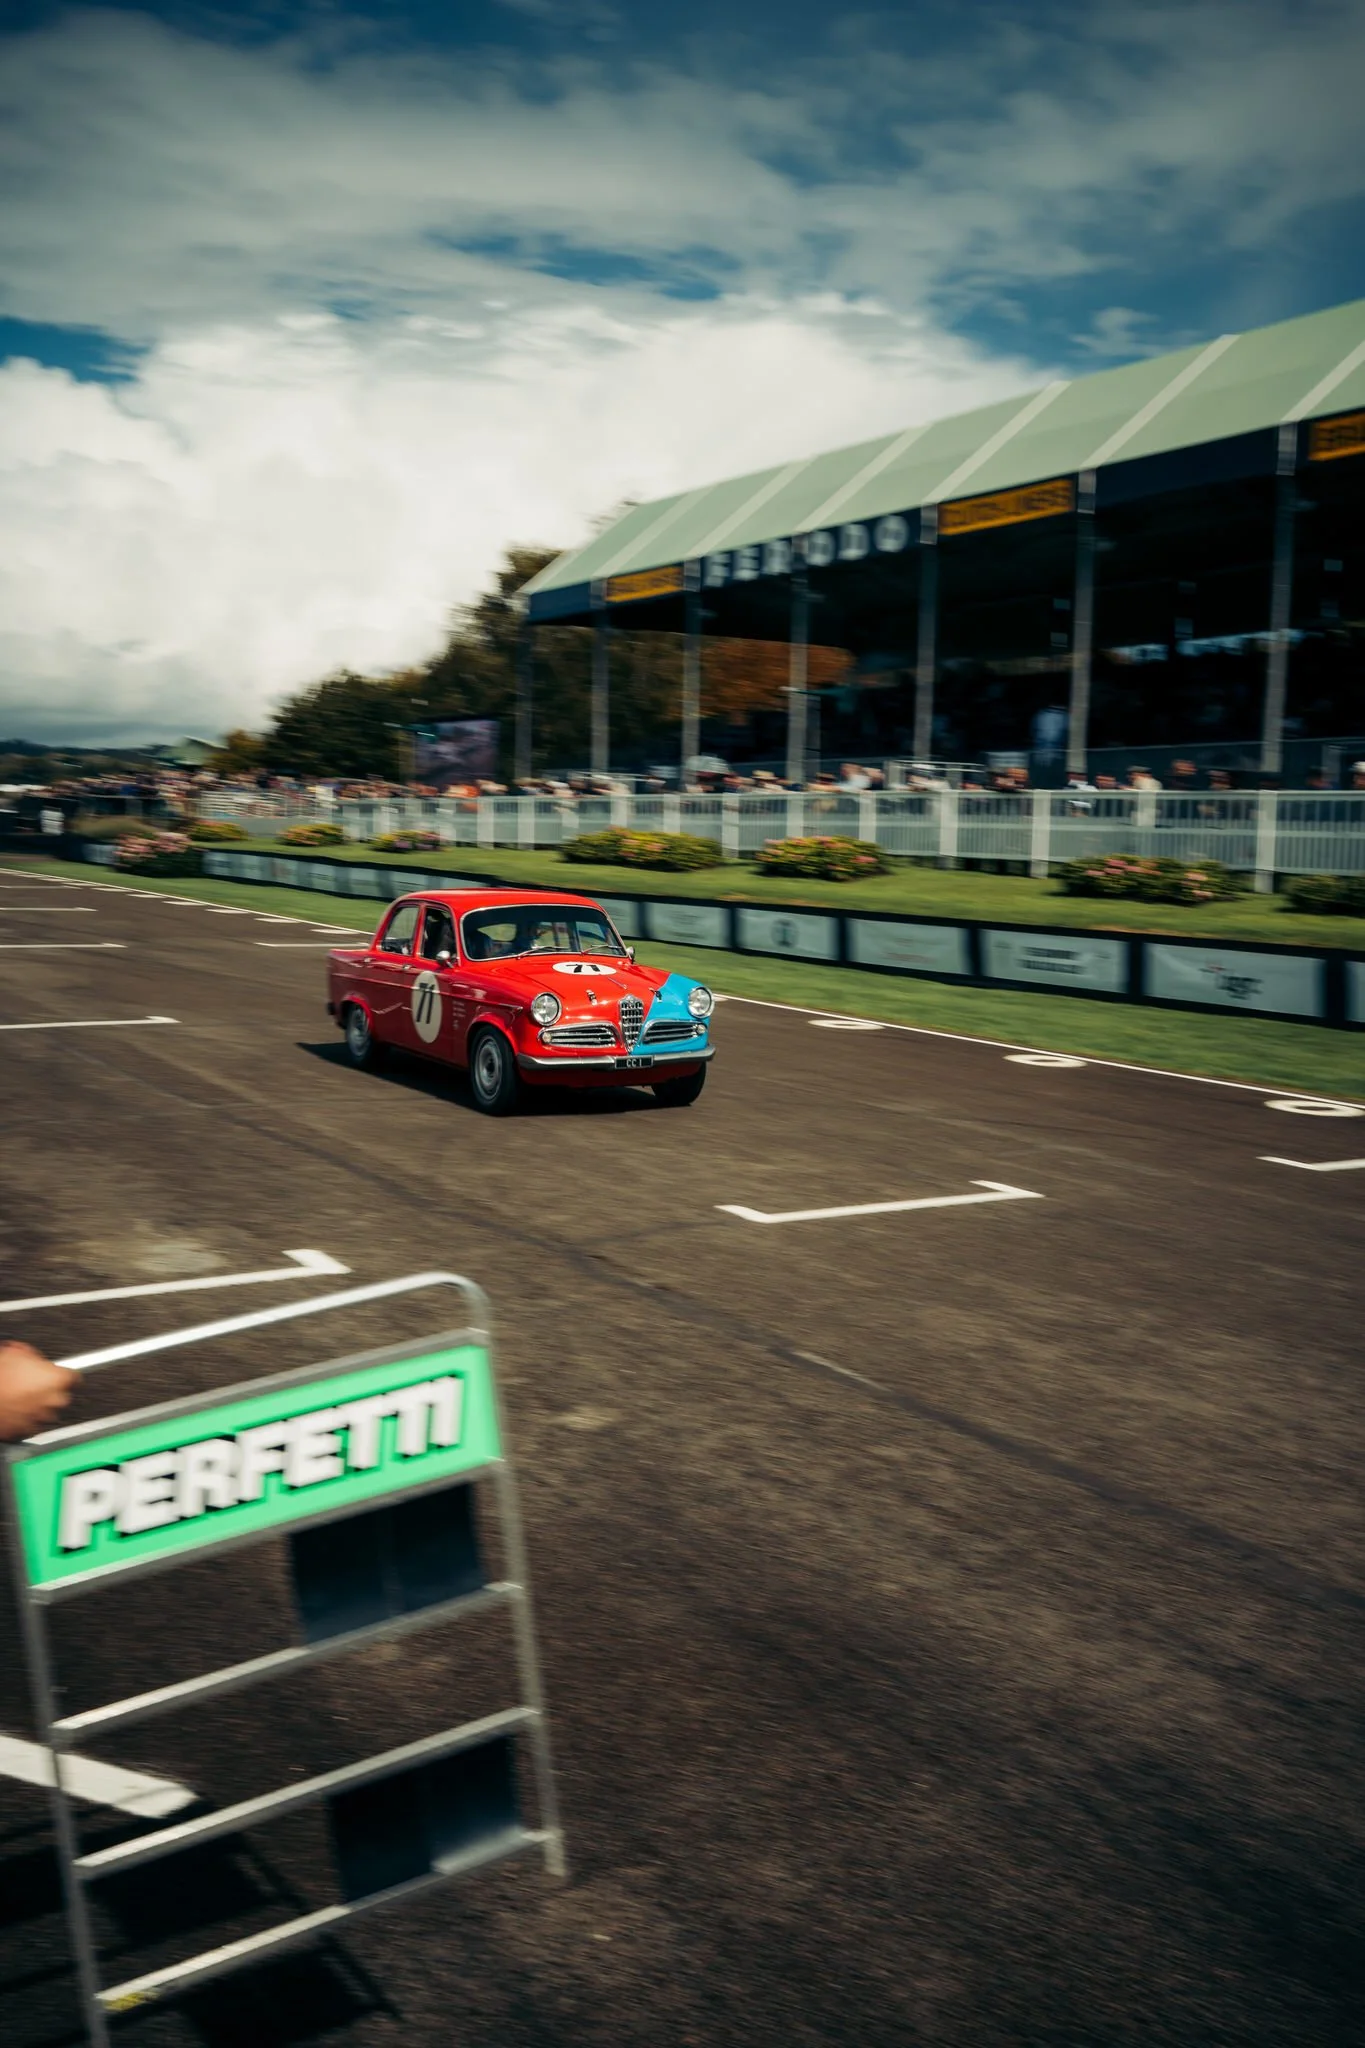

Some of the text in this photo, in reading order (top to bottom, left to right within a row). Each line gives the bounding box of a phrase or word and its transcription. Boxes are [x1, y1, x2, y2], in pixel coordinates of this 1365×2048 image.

[565, 964, 601, 974] 71
[416, 982, 436, 1025] 71
[56, 1375, 464, 1551] PERFETTI
